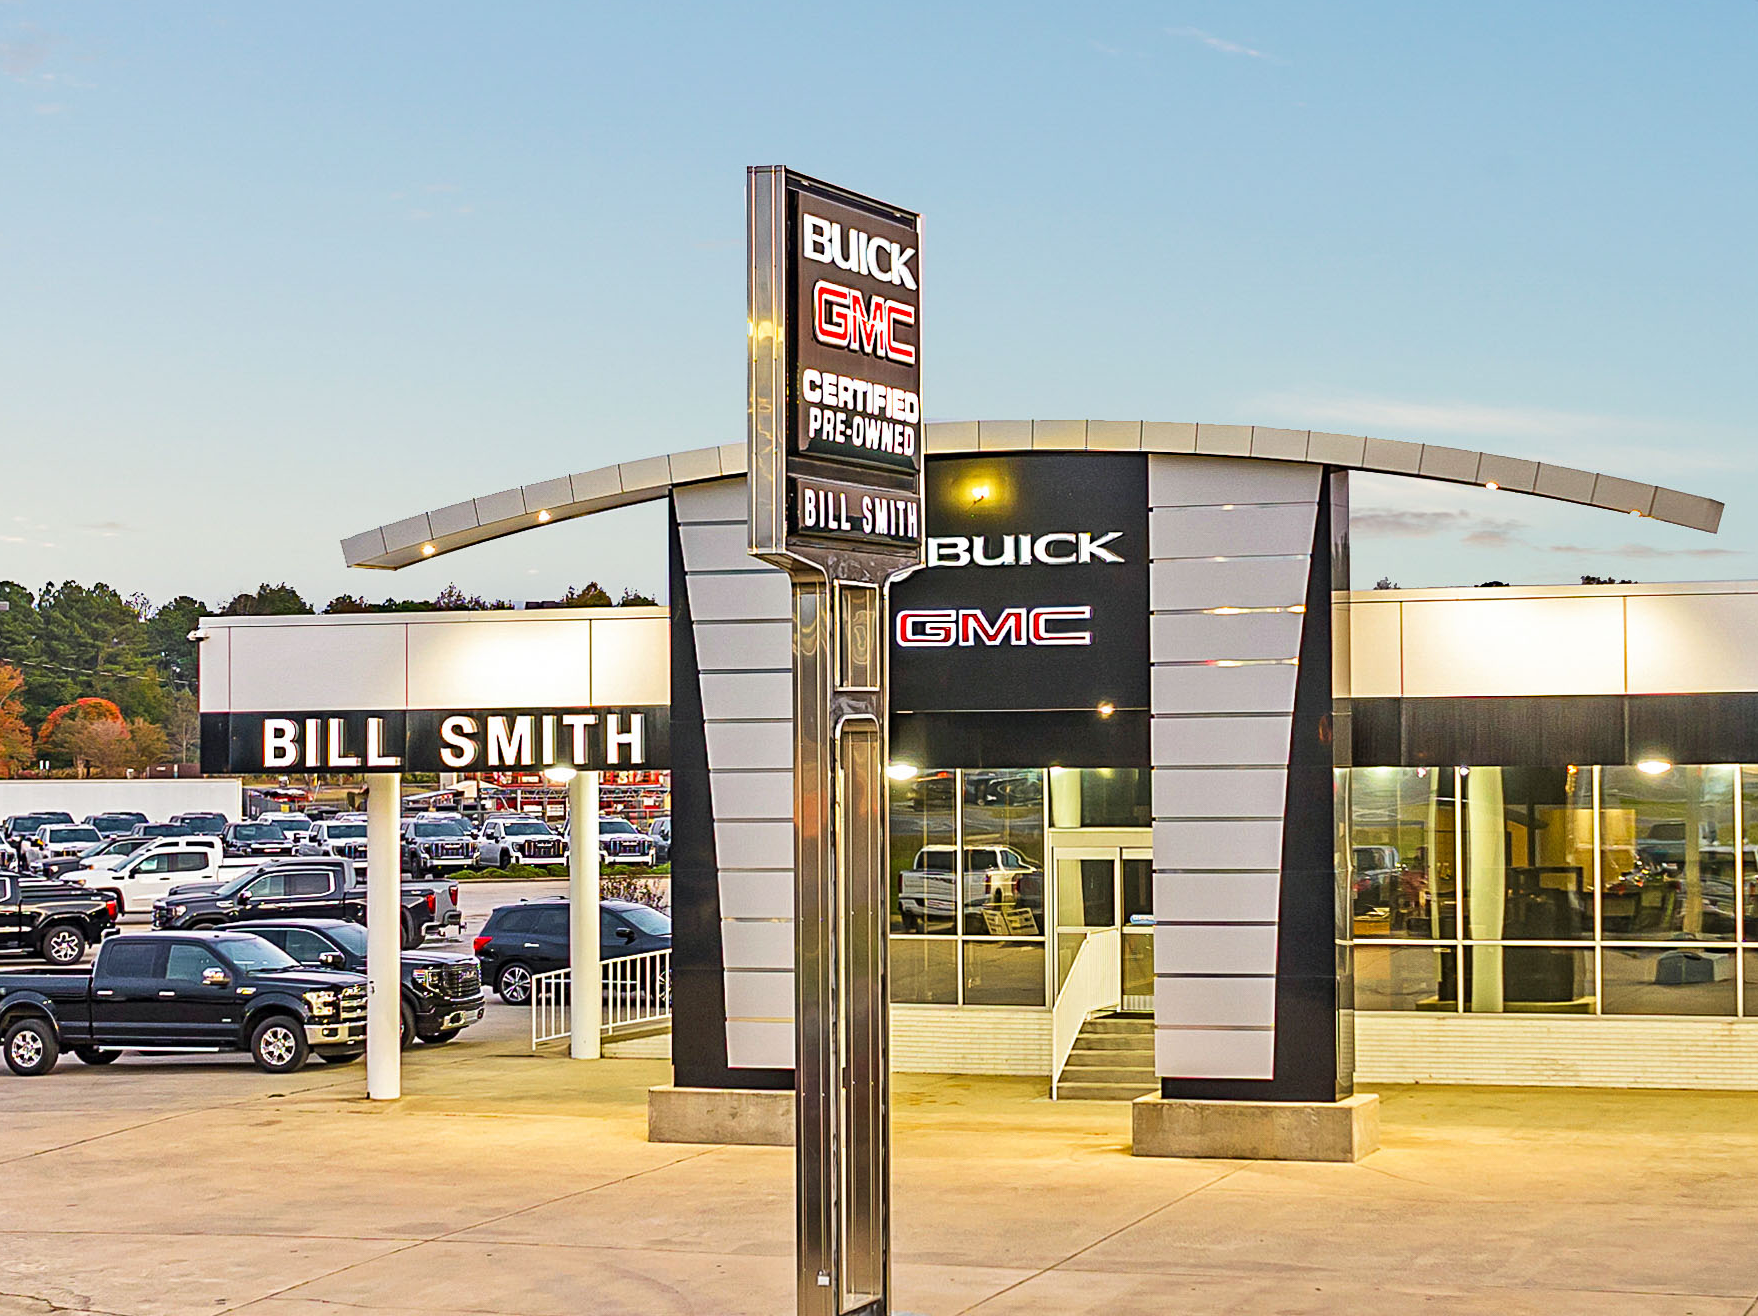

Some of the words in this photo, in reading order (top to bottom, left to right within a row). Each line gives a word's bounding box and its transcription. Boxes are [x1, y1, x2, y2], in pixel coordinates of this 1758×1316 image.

[803, 213, 918, 290] BUICK
[813, 279, 916, 365] GMC
[802, 369, 919, 423] CERTIFIED
[808, 408, 916, 457] PRE-OWNED
[804, 488, 851, 531] BILL
[862, 495, 918, 538] SMITH
[927, 532, 1125, 567] BUICK
[896, 605, 1092, 647] GMC
[262, 717, 404, 769] BILL
[440, 713, 646, 767] SMITH
